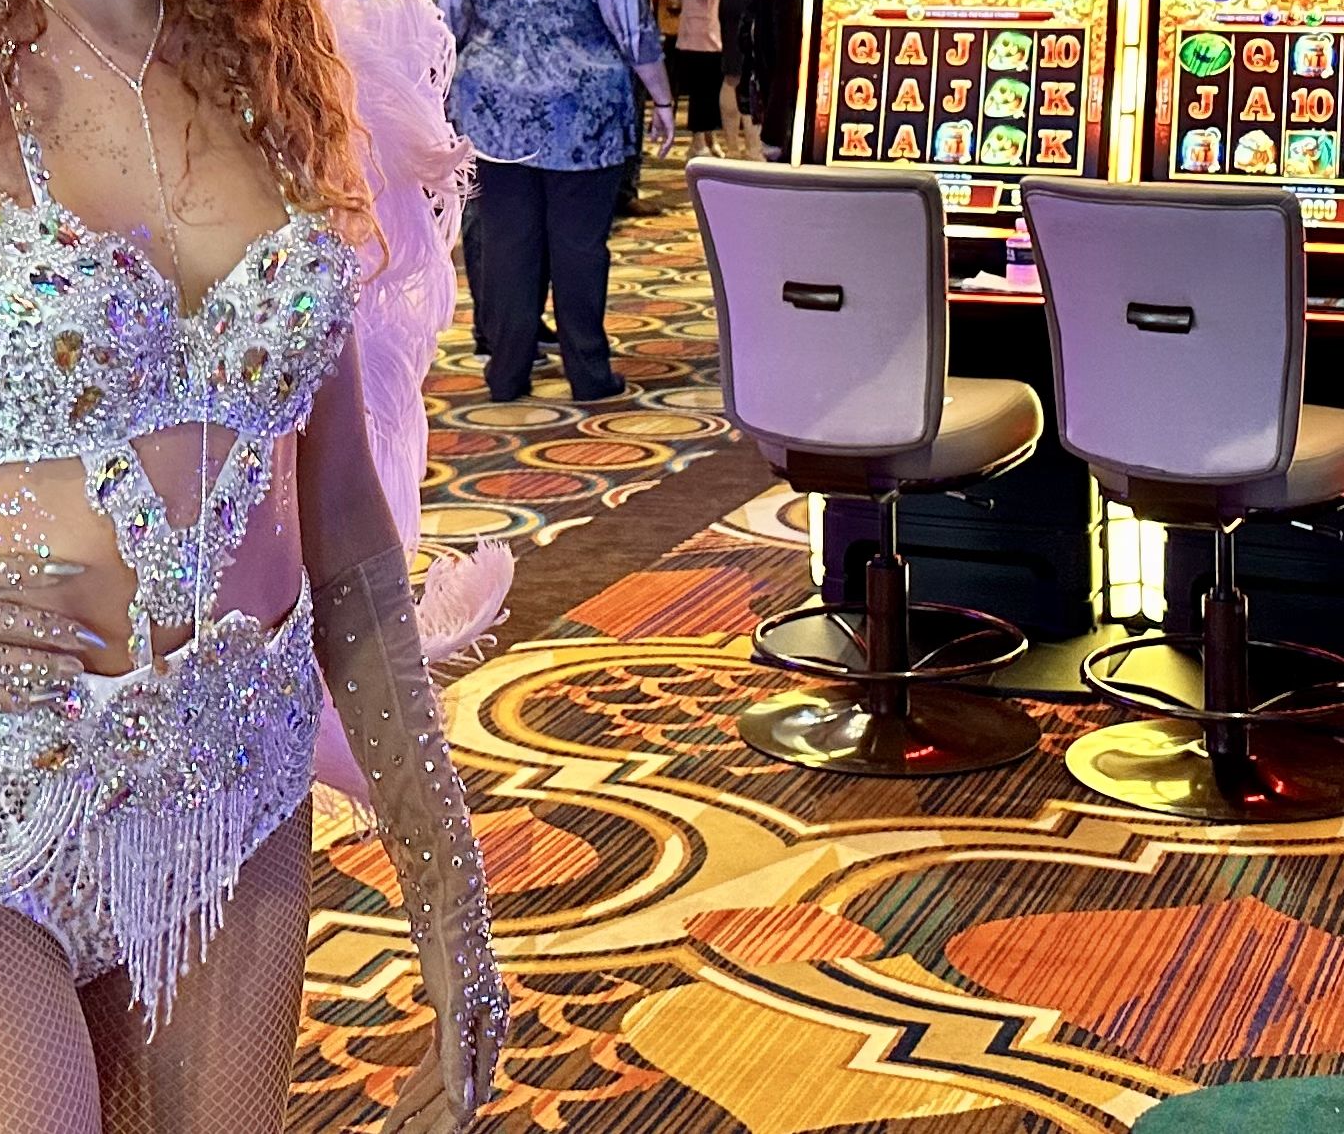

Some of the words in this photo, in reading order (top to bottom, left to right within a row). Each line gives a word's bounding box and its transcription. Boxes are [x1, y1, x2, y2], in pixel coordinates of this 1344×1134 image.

[847, 31, 880, 65] Q
[895, 32, 928, 65] A
[945, 33, 975, 66] J
[1040, 34, 1081, 69] 10
[1243, 38, 1279, 73] Q
[844, 77, 878, 111] Q
[891, 78, 924, 112] A
[942, 79, 972, 113] J
[1040, 81, 1076, 116] K
[1188, 86, 1219, 120] J
[1240, 86, 1275, 122] A
[1291, 88, 1335, 123] 10
[839, 123, 873, 157] K
[888, 124, 921, 159] A
[1036, 129, 1072, 164] K
